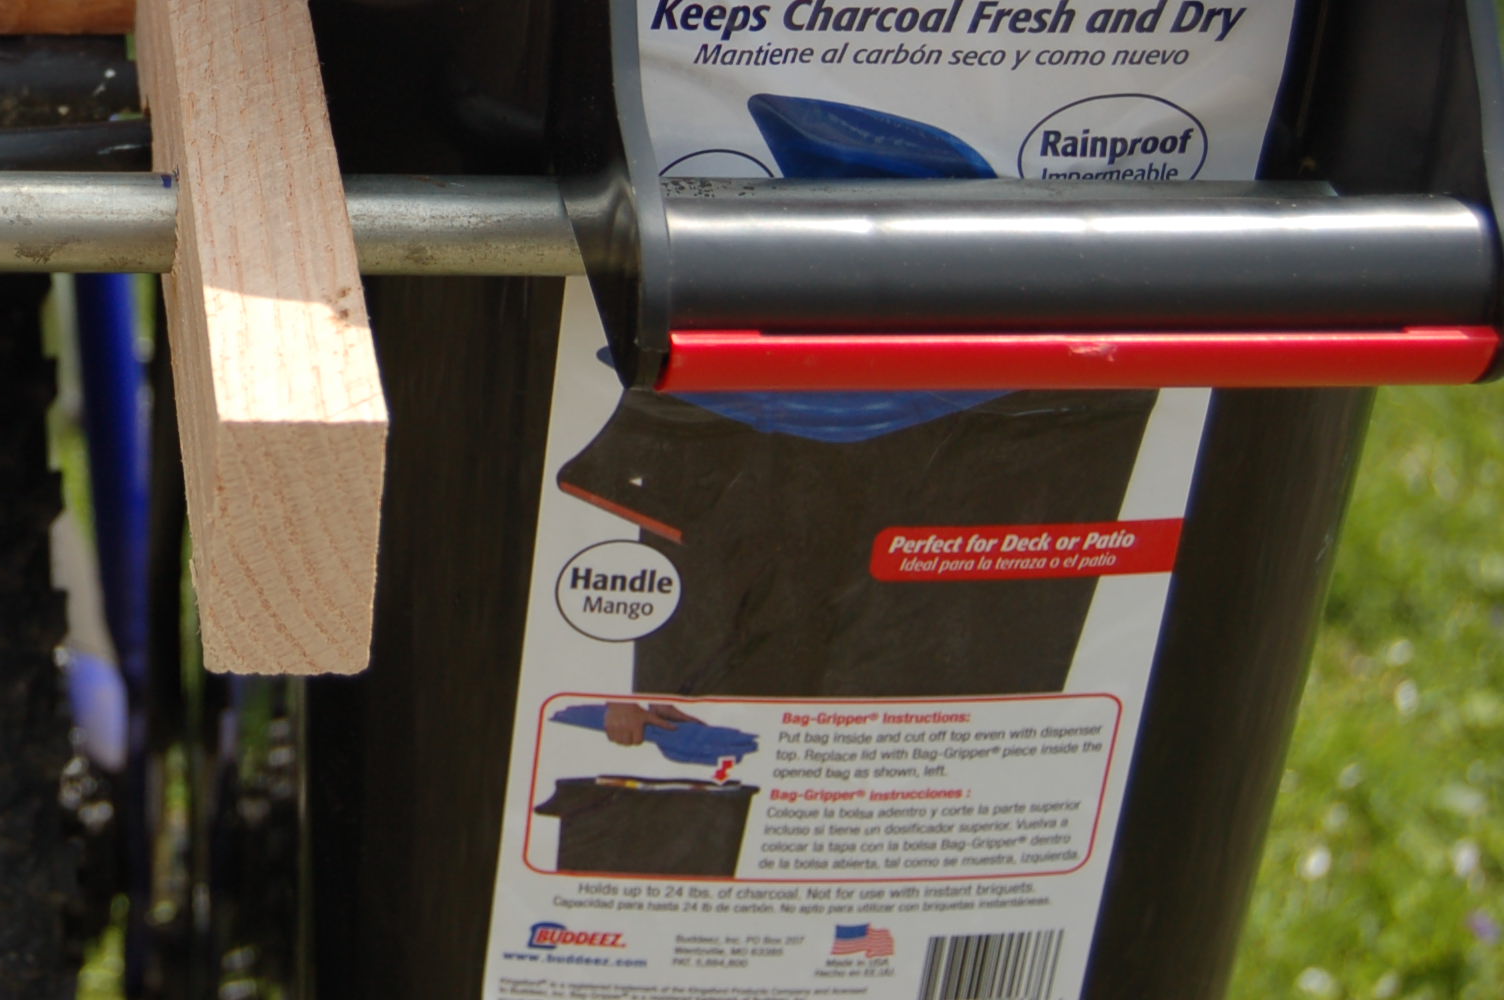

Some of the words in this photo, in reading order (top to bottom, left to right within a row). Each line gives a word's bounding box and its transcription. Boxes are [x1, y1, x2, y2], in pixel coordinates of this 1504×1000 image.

[967, 0, 1076, 33] Fresh
[1085, 0, 1168, 32] and
[1169, 0, 1246, 40] Dry
[692, 43, 814, 65] Mantiene
[820, 42, 849, 63] al
[852, 43, 942, 64] carbón
[947, 49, 1006, 66] seco
[1011, 49, 1030, 70] y
[1035, 49, 1105, 65] como
[1111, 49, 1189, 64] nuevo
[1040, 128, 1194, 165] Rainproof
[888, 535, 963, 553] Perfect
[965, 534, 998, 552] for
[1000, 533, 1052, 551] Deck
[1055, 536, 1080, 550] or
[1082, 530, 1135, 549] Patio
[899, 556, 939, 571] Ideal
[937, 559, 975, 573] para
[976, 555, 993, 570] la
[994, 557, 1047, 569] terraza
[1049, 557, 1060, 568] o
[1062, 553, 1079, 567] el
[1077, 552, 1116, 569] patio
[569, 567, 673, 593] Handle
[582, 596, 654, 619] Mango
